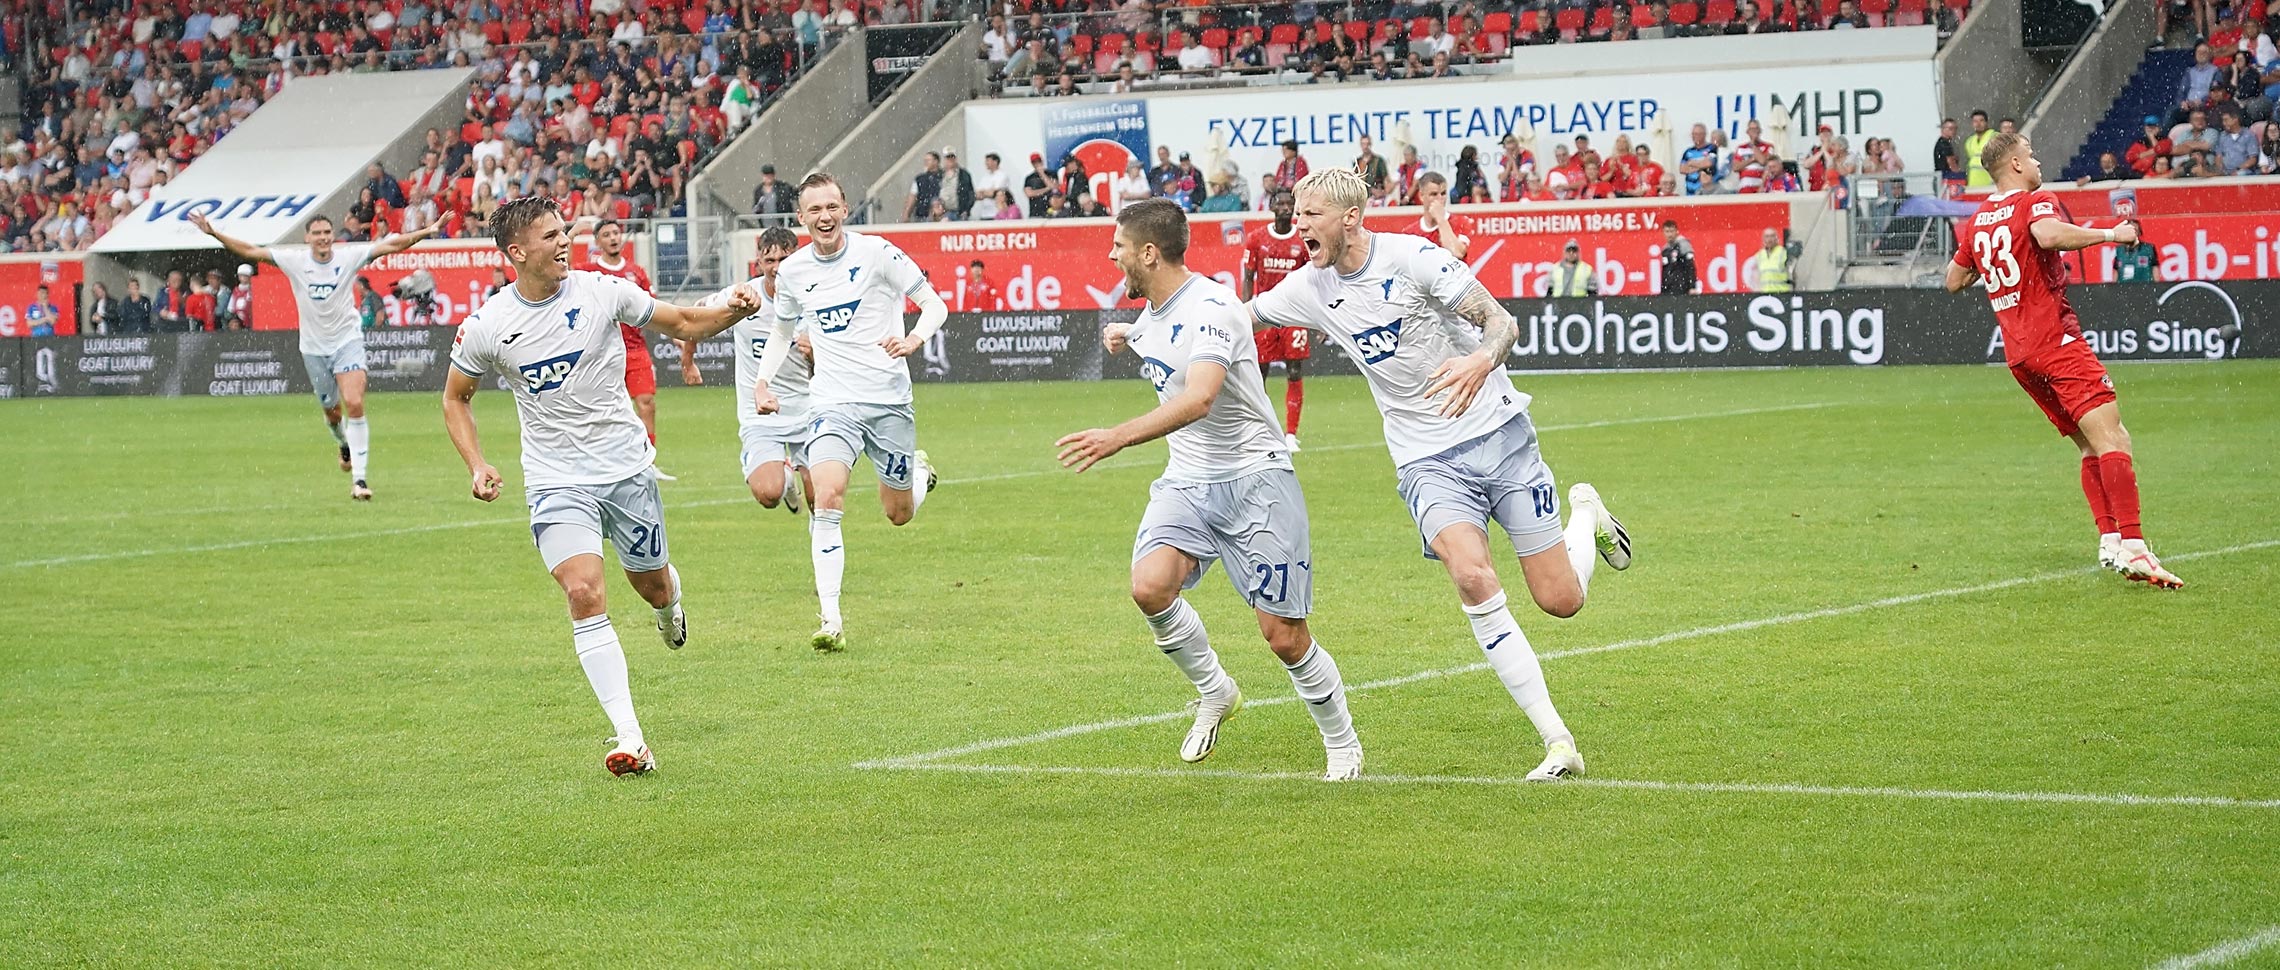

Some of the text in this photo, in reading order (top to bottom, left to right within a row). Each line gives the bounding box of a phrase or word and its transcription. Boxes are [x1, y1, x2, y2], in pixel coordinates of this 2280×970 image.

[1423, 99, 1659, 140] TEAMPLAYER
[1771, 88, 1884, 137] MHP
[1048, 117, 1145, 137] HEIDENHEIM 1846
[145, 194, 319, 222] VOITH
[1477, 213, 1582, 235] HEIDENHEIM
[1584, 212, 1624, 232] 1846
[1625, 213, 1641, 231] E.
[1642, 212, 1660, 230] V.
[940, 232, 1038, 253] NUR DER FCH
[387, 251, 470, 270] HEIDENHEIM
[471, 250, 502, 268] 1846
[1273, 258, 1297, 269] MHP
[1974, 225, 2021, 293] 33
[309, 285, 334, 298] SAP
[817, 307, 854, 330] SAP
[982, 315, 1063, 333] LUXUSUHR?
[1514, 295, 1884, 365] utohaus Sing
[975, 335, 1071, 353] GOAT LUXURY
[1208, 324, 1231, 343] hep
[1292, 329, 1308, 348] 23
[1357, 330, 1399, 358] SAP
[2147, 321, 2226, 359] Sing
[83, 337, 149, 354] LUXUSUHR?
[78, 354, 155, 372] GOAT LUXURY
[214, 361, 282, 378] LUXUSUHR?
[523, 361, 572, 389] SAP
[209, 379, 288, 396] GOAT LUXURY
[885, 452, 908, 481] 14
[1532, 483, 1554, 518] 10
[628, 523, 662, 558] 20
[1256, 563, 1289, 602] 27
